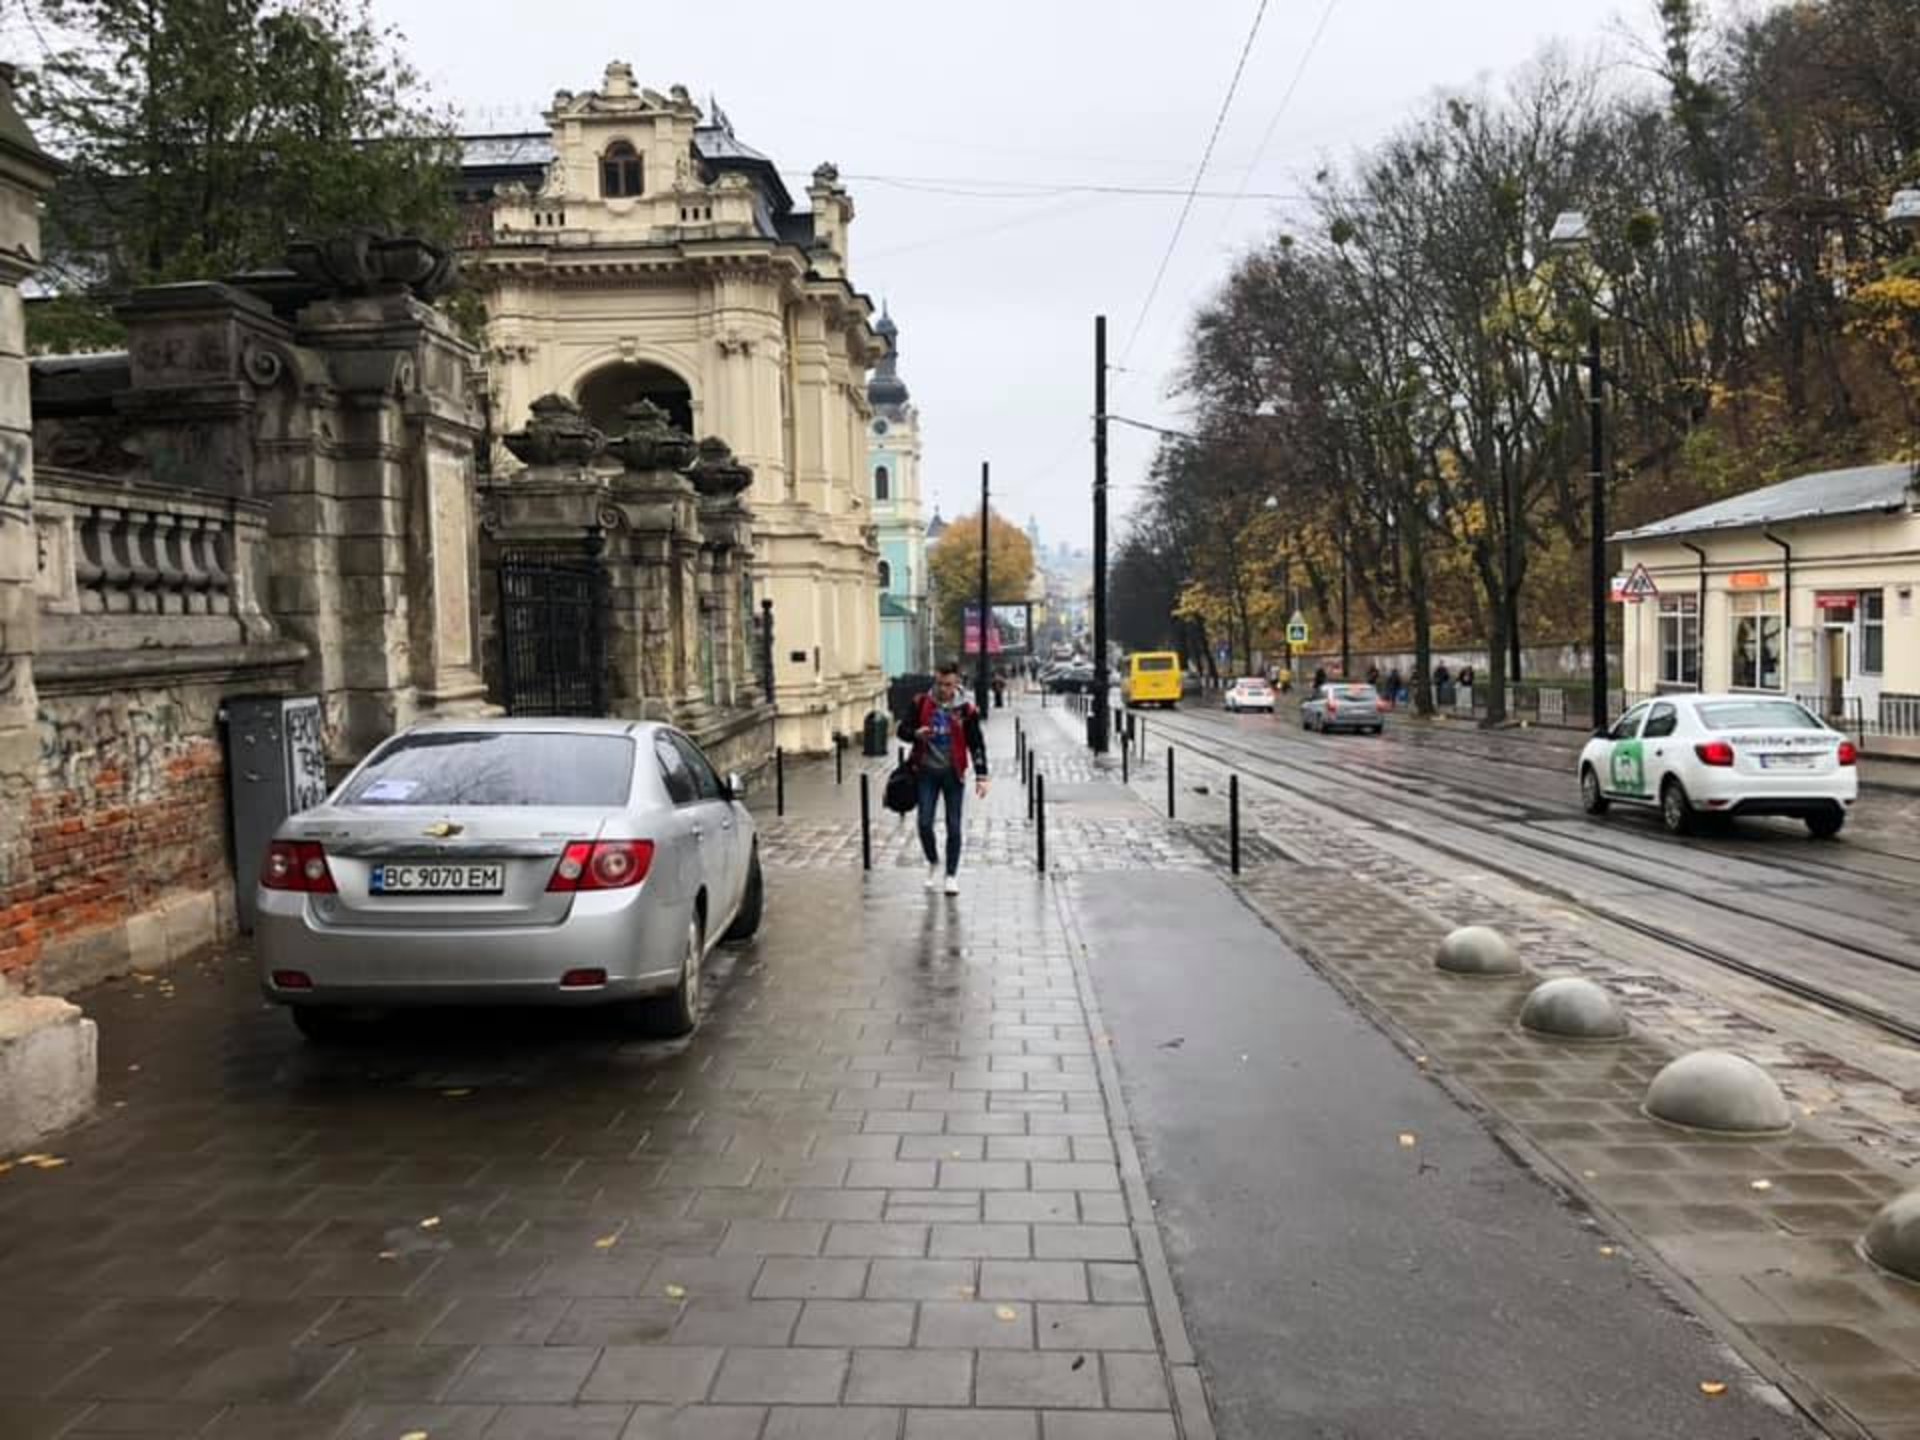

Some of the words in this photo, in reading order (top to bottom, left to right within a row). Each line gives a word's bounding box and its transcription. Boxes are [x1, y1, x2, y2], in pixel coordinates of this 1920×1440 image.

[385, 867, 412, 887] BC
[418, 867, 463, 887] 9070
[467, 867, 497, 887] EM
